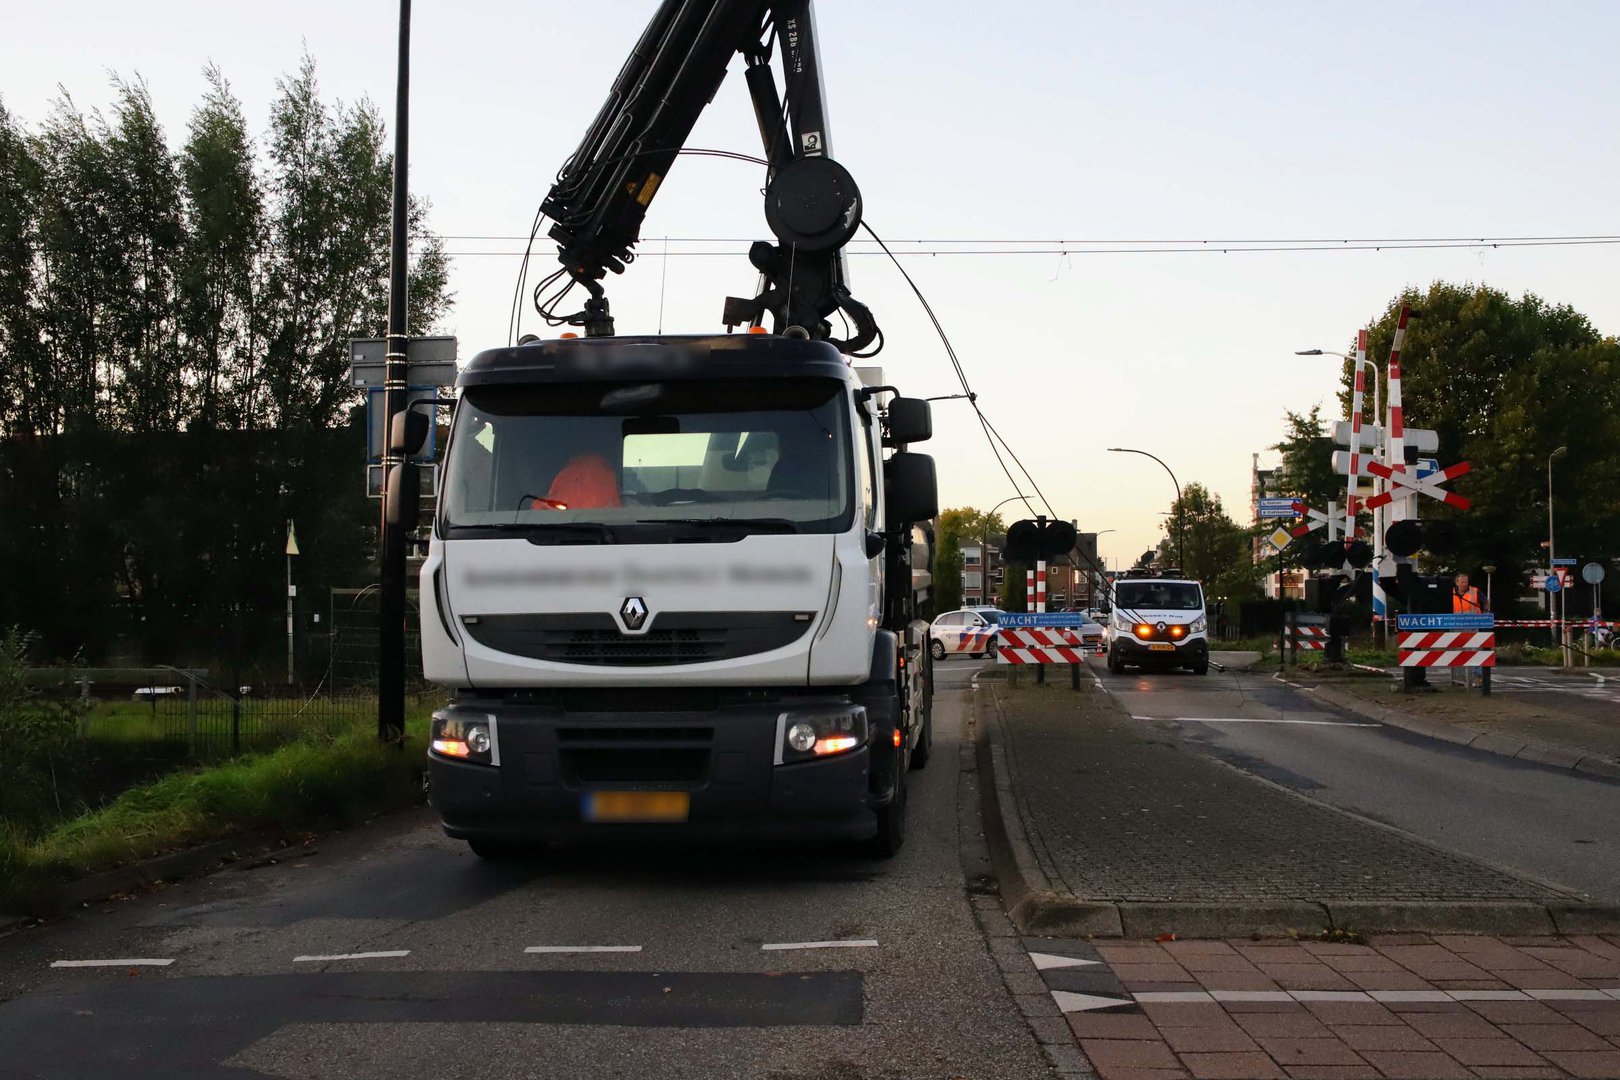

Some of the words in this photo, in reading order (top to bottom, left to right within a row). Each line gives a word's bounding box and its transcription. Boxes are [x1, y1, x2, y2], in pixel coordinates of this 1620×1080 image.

[788, 19, 796, 29] XS
[999, 616, 1038, 625] WACHT
[1400, 617, 1443, 626] WACHT
